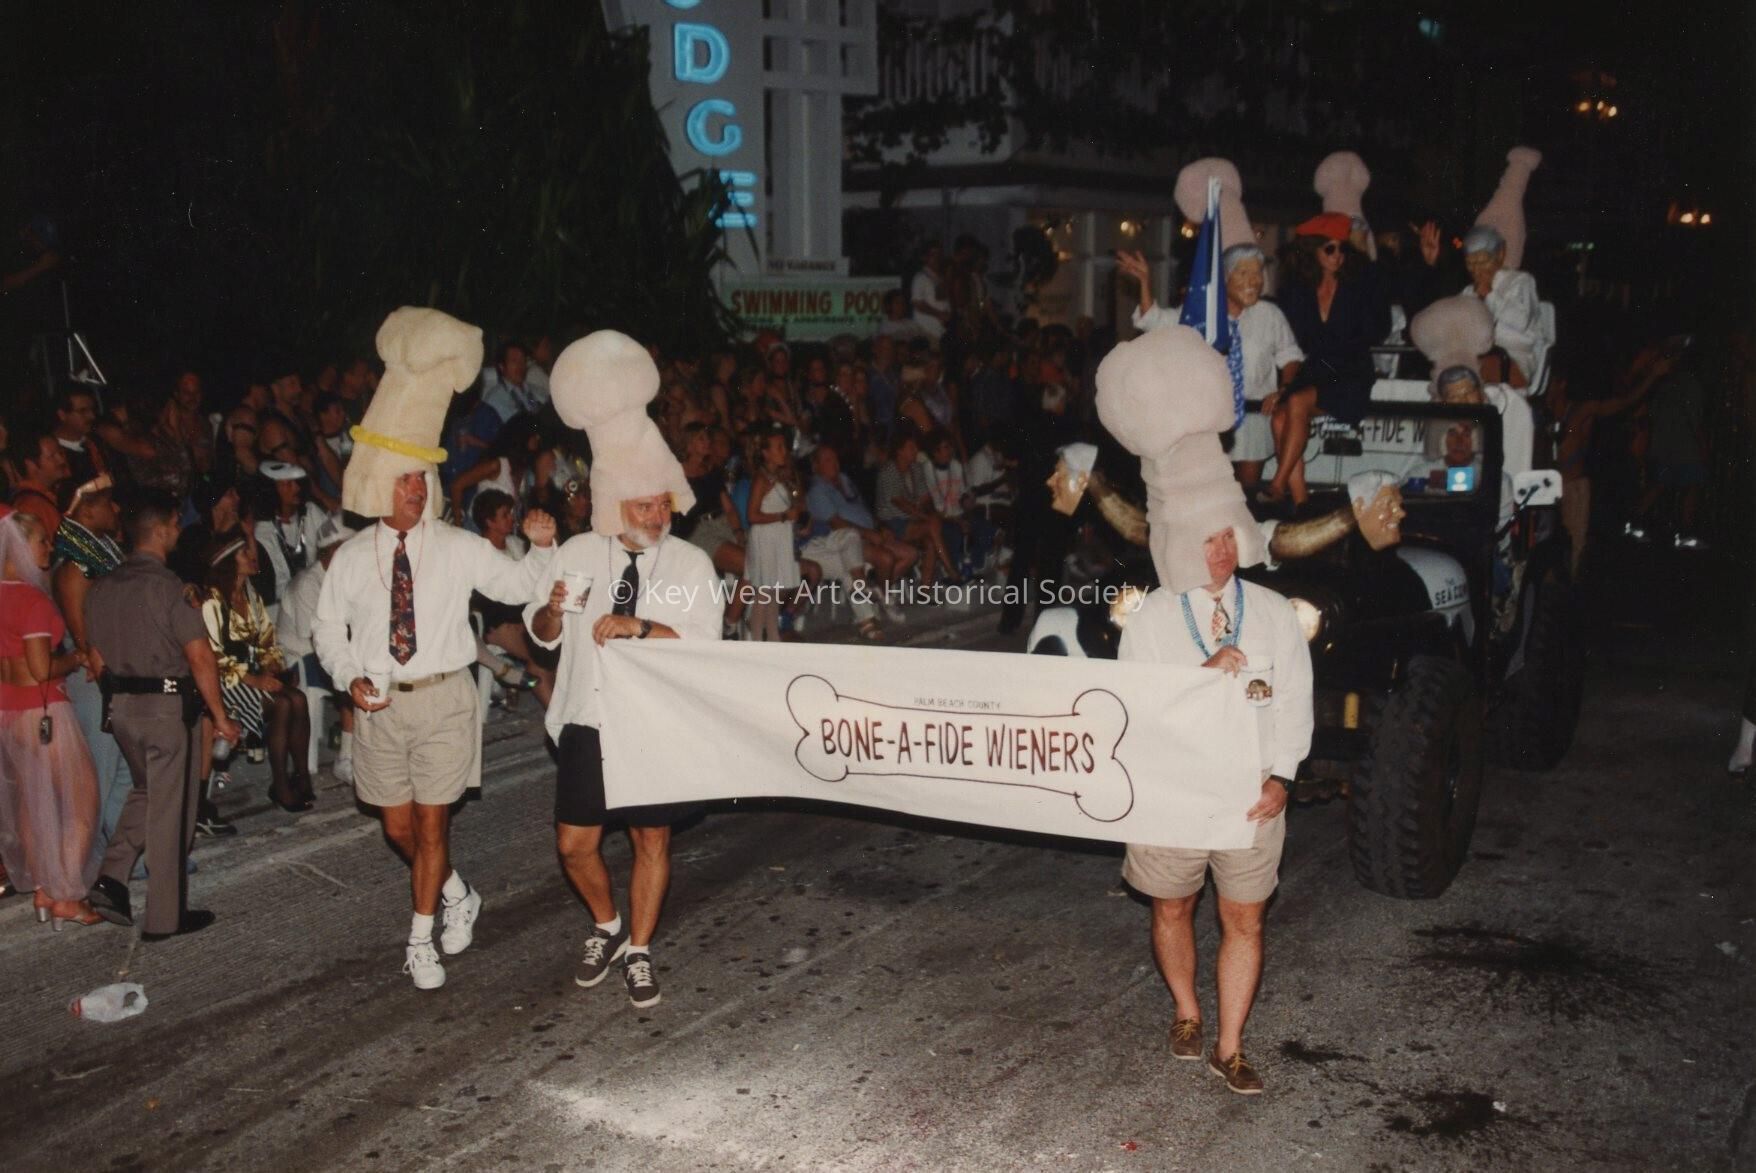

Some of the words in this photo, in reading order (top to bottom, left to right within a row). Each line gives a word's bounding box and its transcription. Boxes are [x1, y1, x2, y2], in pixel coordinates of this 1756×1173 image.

[663, 0, 757, 228] DGE
[731, 289, 833, 315] SWIMMING
[913, 696, 935, 706] PALM
[937, 697, 965, 708] BEACH
[966, 700, 1002, 711] COUNTY
[820, 717, 974, 766] BONE-A-FIDE
[985, 723, 1095, 774] WIENERS
